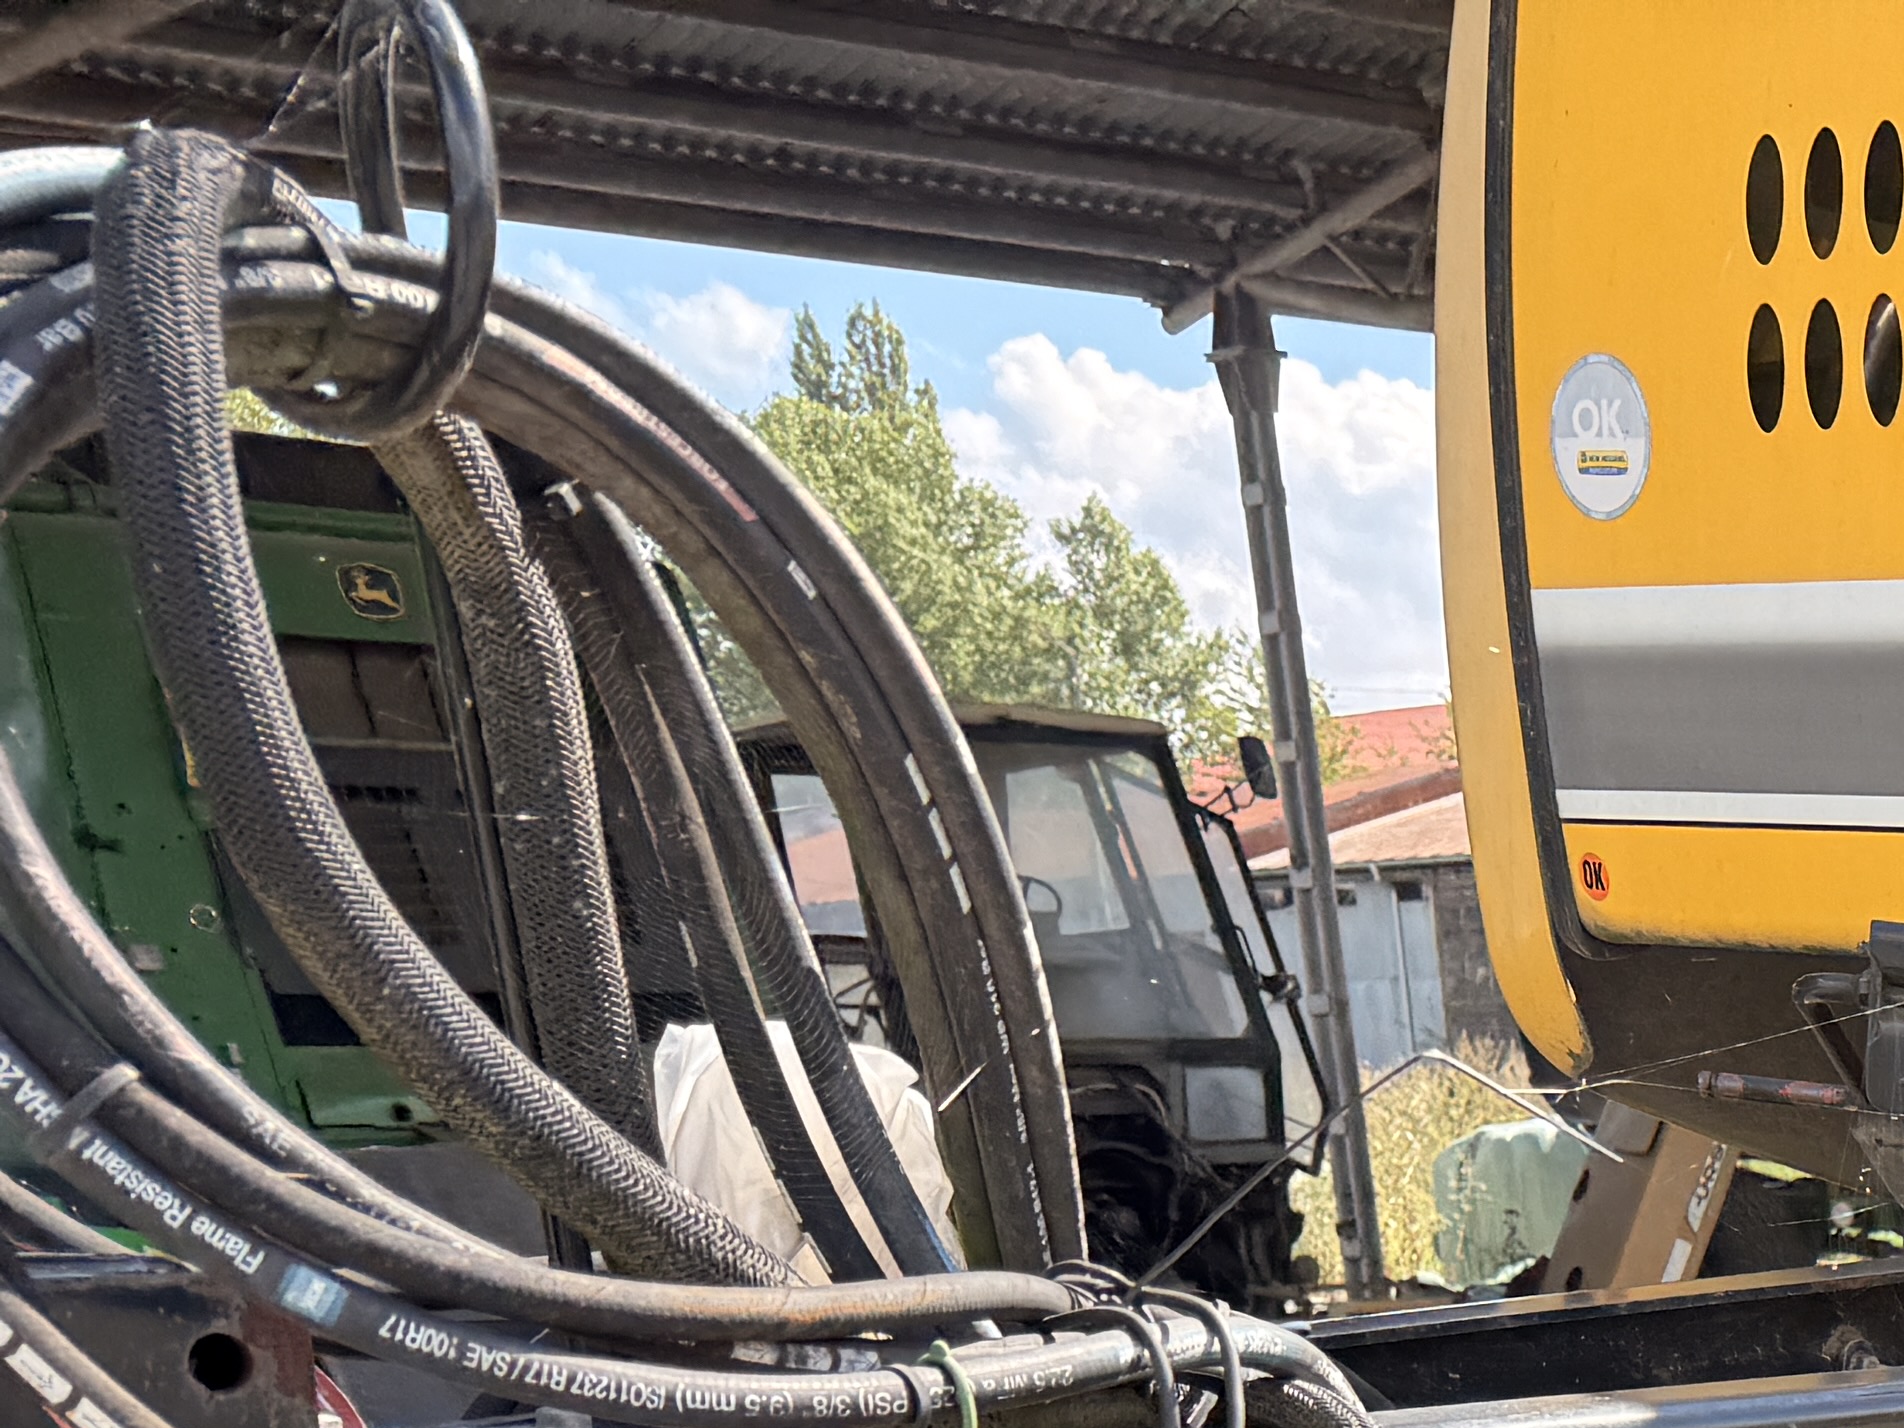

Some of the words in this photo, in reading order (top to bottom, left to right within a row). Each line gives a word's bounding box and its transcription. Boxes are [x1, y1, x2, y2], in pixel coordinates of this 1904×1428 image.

[1572, 398, 1625, 440] OK
[1582, 859, 1606, 892] OK
[81, 1136, 190, 1230] Resistant
[190, 1213, 266, 1275] Flame
